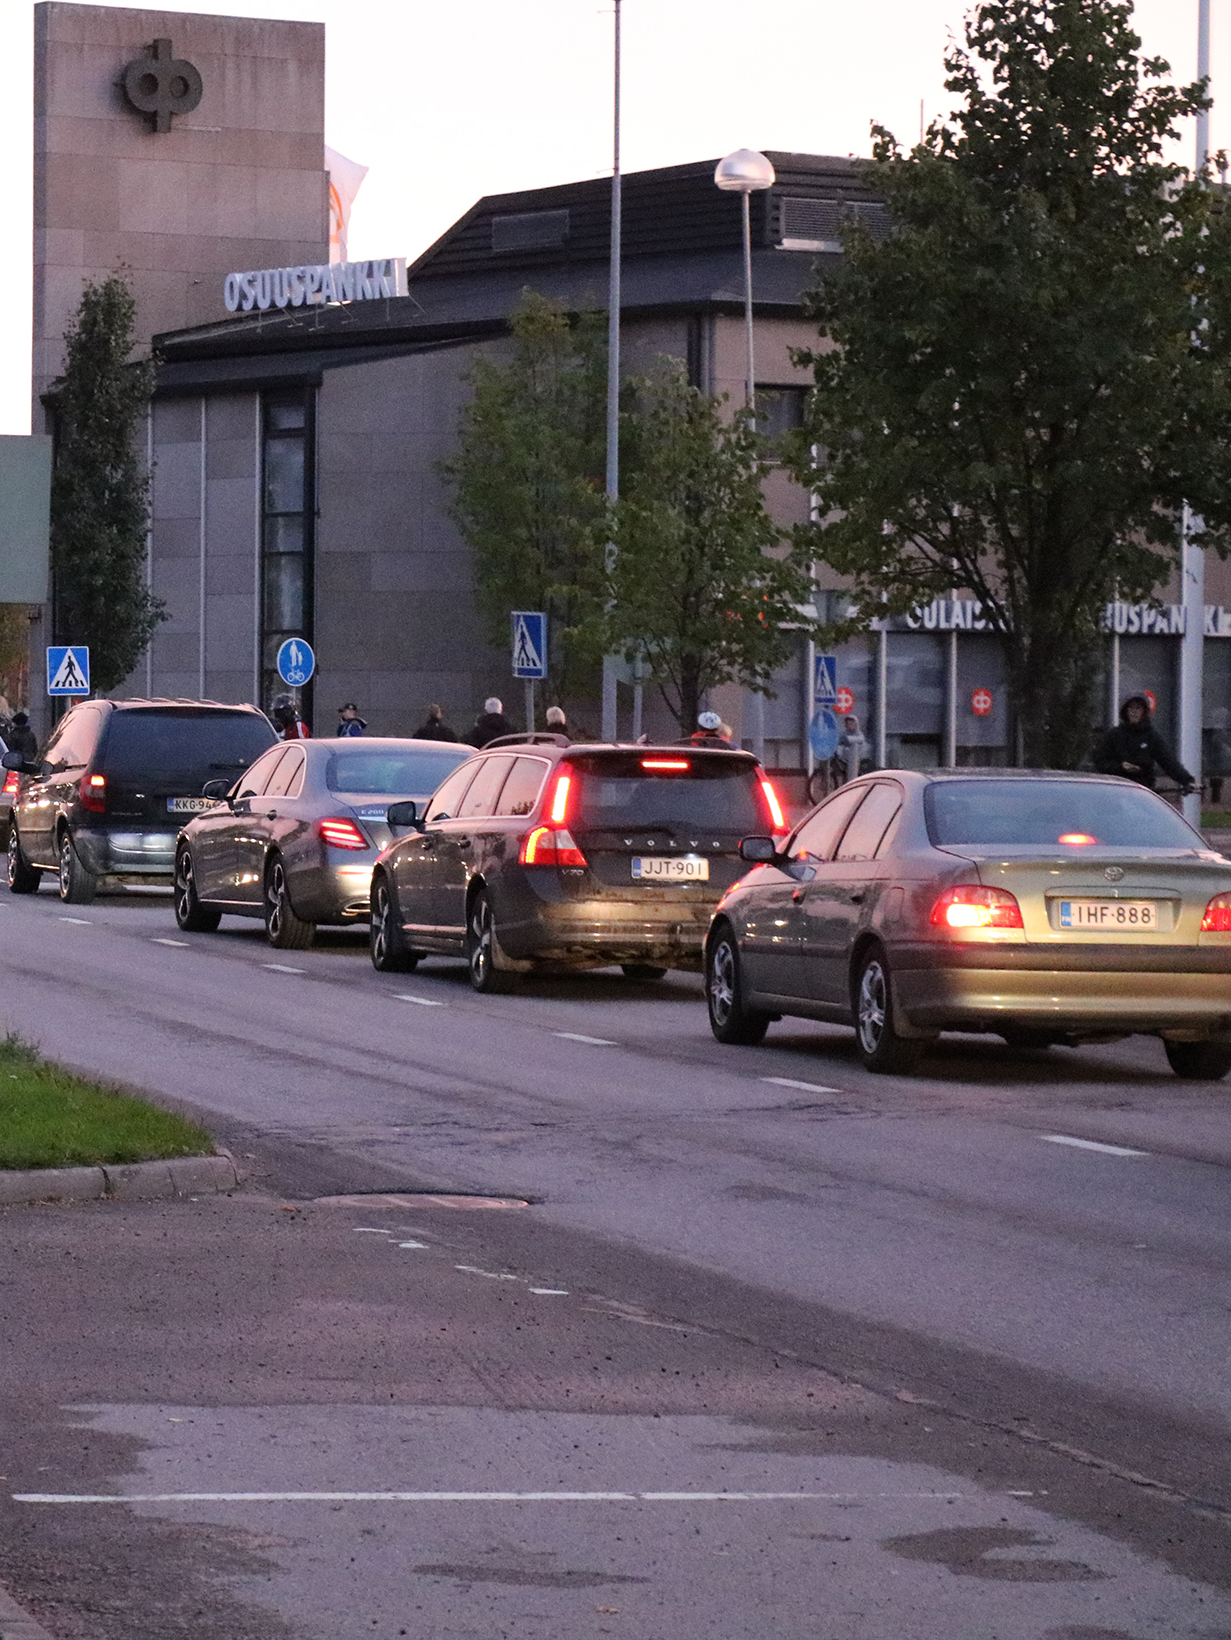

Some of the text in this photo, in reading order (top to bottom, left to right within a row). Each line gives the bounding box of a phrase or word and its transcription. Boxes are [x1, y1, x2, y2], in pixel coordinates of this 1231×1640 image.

[224, 257, 409, 311] OSUUSPANKKI
[624, 839, 720, 848] VOLVO
[644, 861, 702, 876] JJT-901
[1078, 906, 1152, 924] IHF-888
